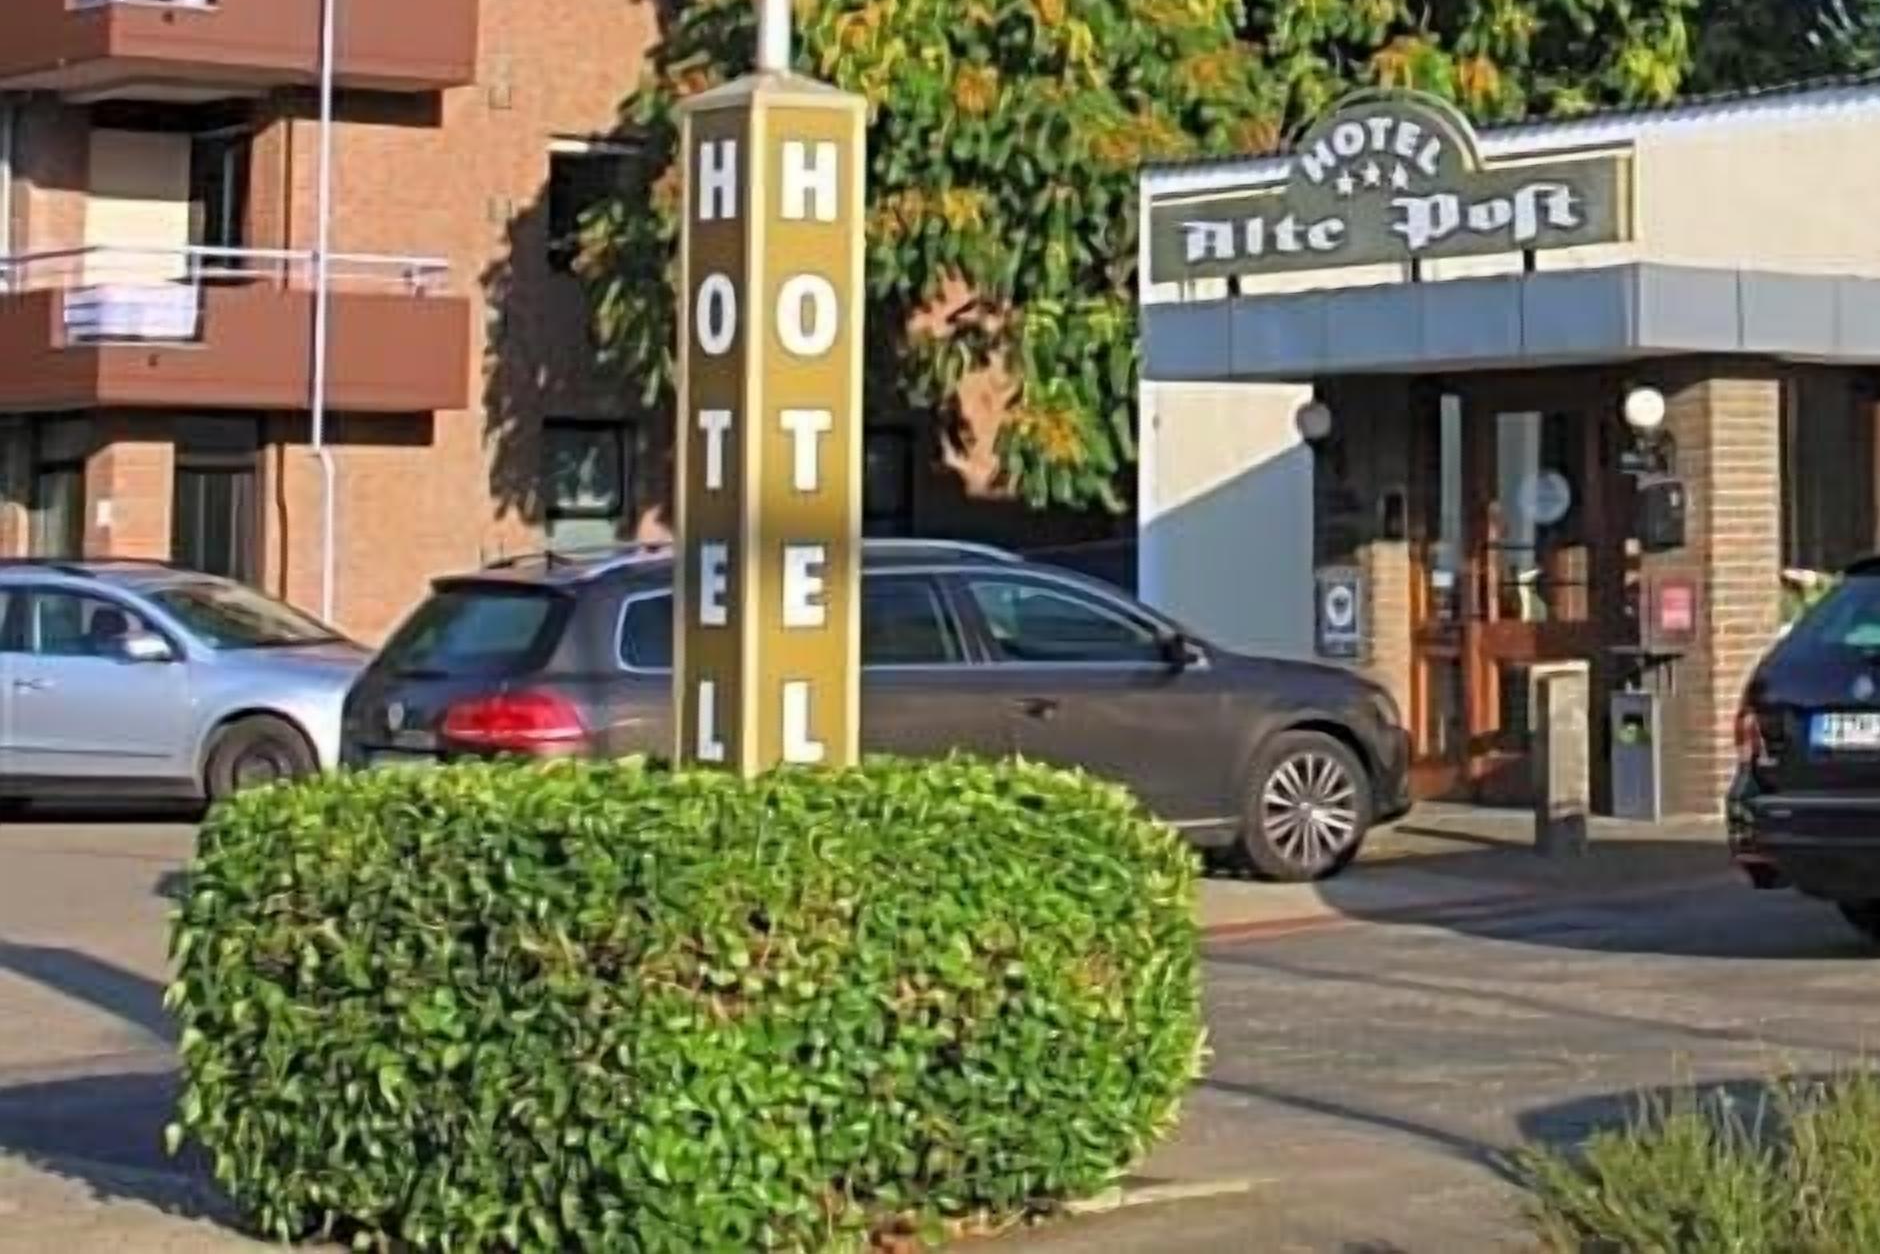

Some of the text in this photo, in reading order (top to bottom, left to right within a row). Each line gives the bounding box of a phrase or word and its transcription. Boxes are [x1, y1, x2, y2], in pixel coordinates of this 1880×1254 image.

[1181, 212, 1346, 263] Alte
[1300, 116, 1441, 184] HOTEL
[696, 140, 738, 762] HOTEL
[776, 140, 839, 764] HOTEL
